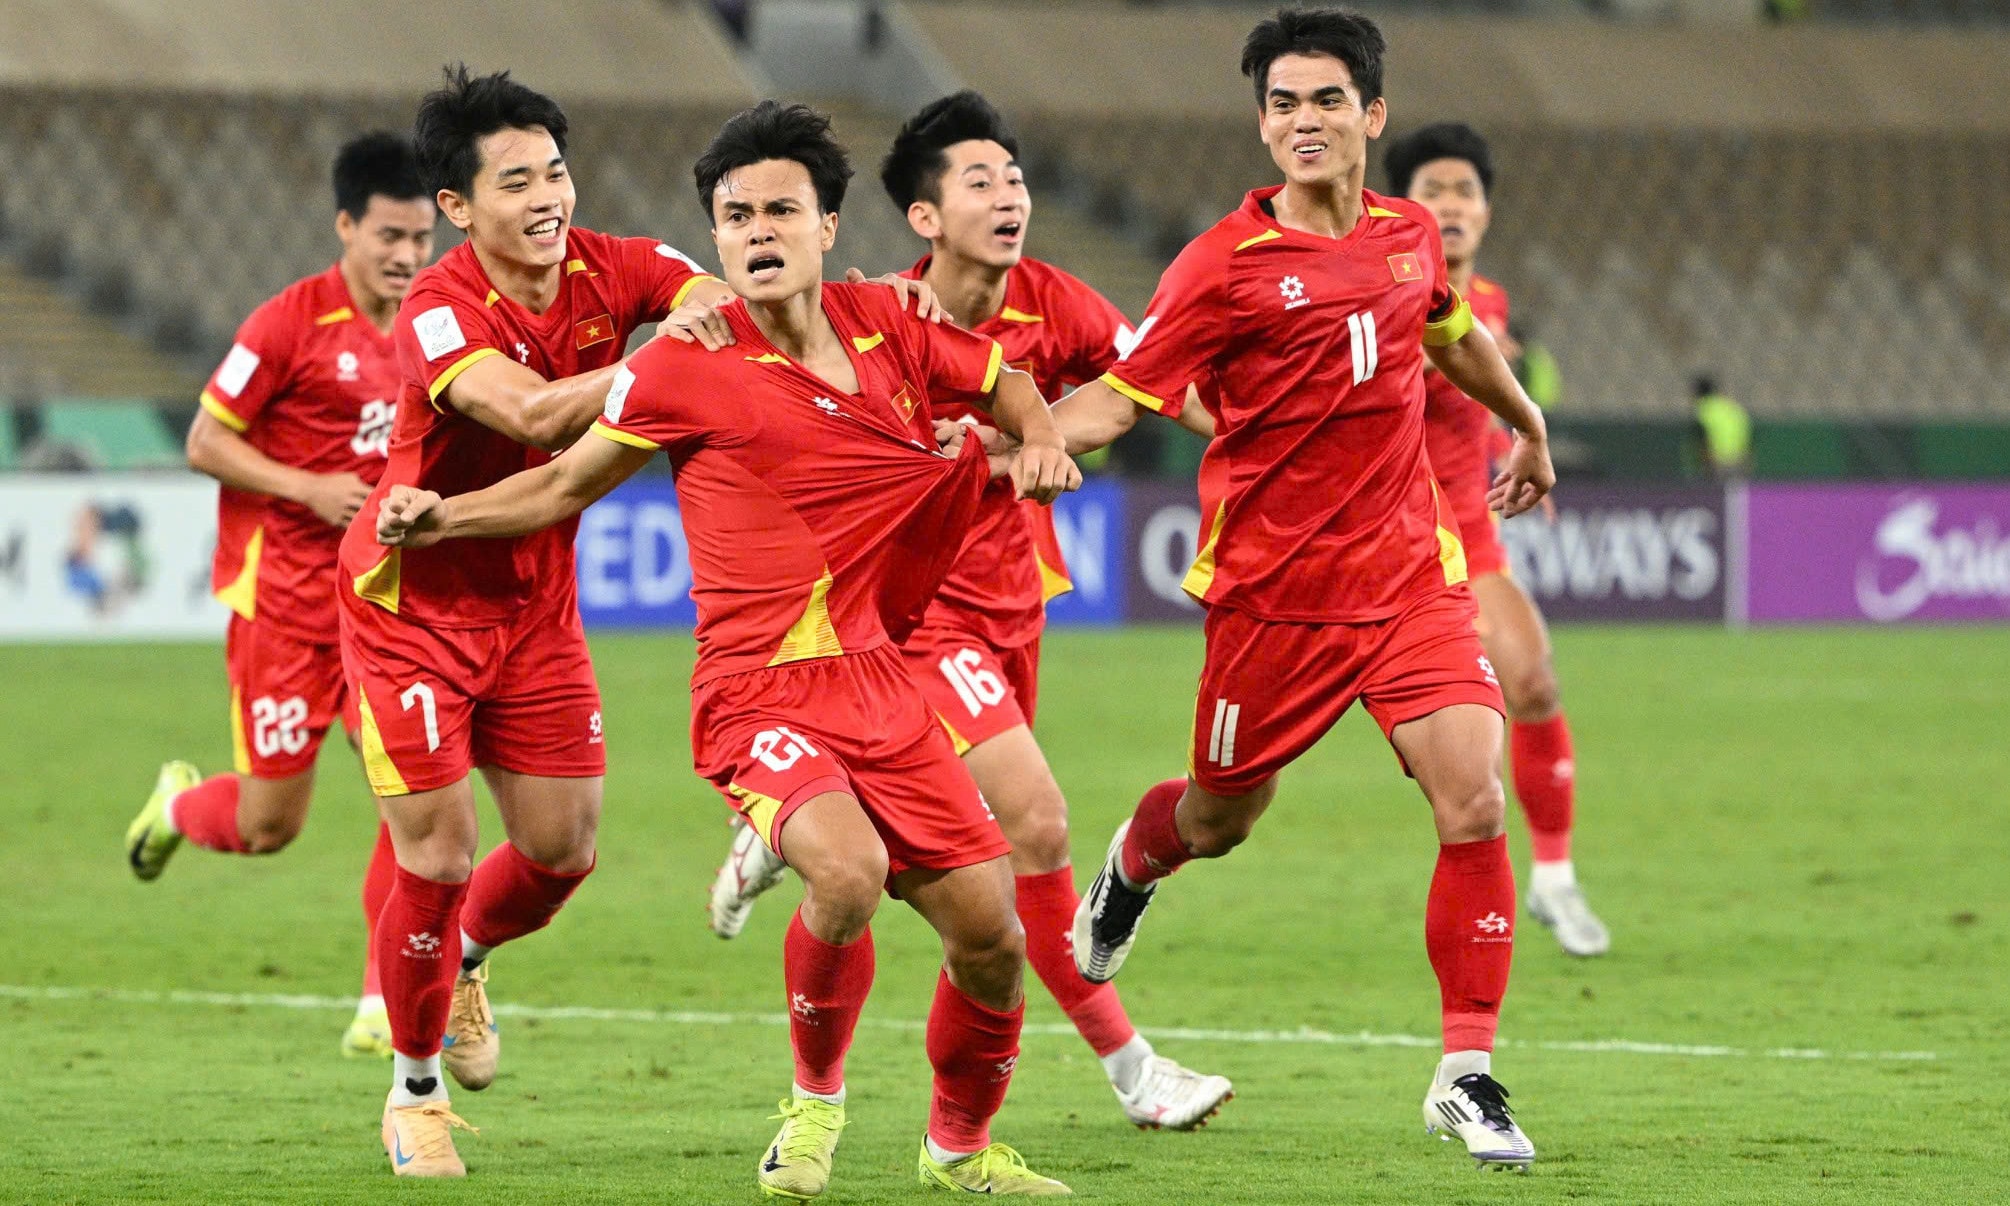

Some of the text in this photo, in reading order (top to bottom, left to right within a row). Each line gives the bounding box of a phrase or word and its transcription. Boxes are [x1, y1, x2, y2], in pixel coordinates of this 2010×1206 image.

[1347, 310, 1378, 387] 11
[939, 648, 1005, 718] 16
[251, 694, 310, 758] 22
[400, 681, 440, 755] 7
[750, 726, 819, 773] 21
[1208, 698, 1240, 767] 11
